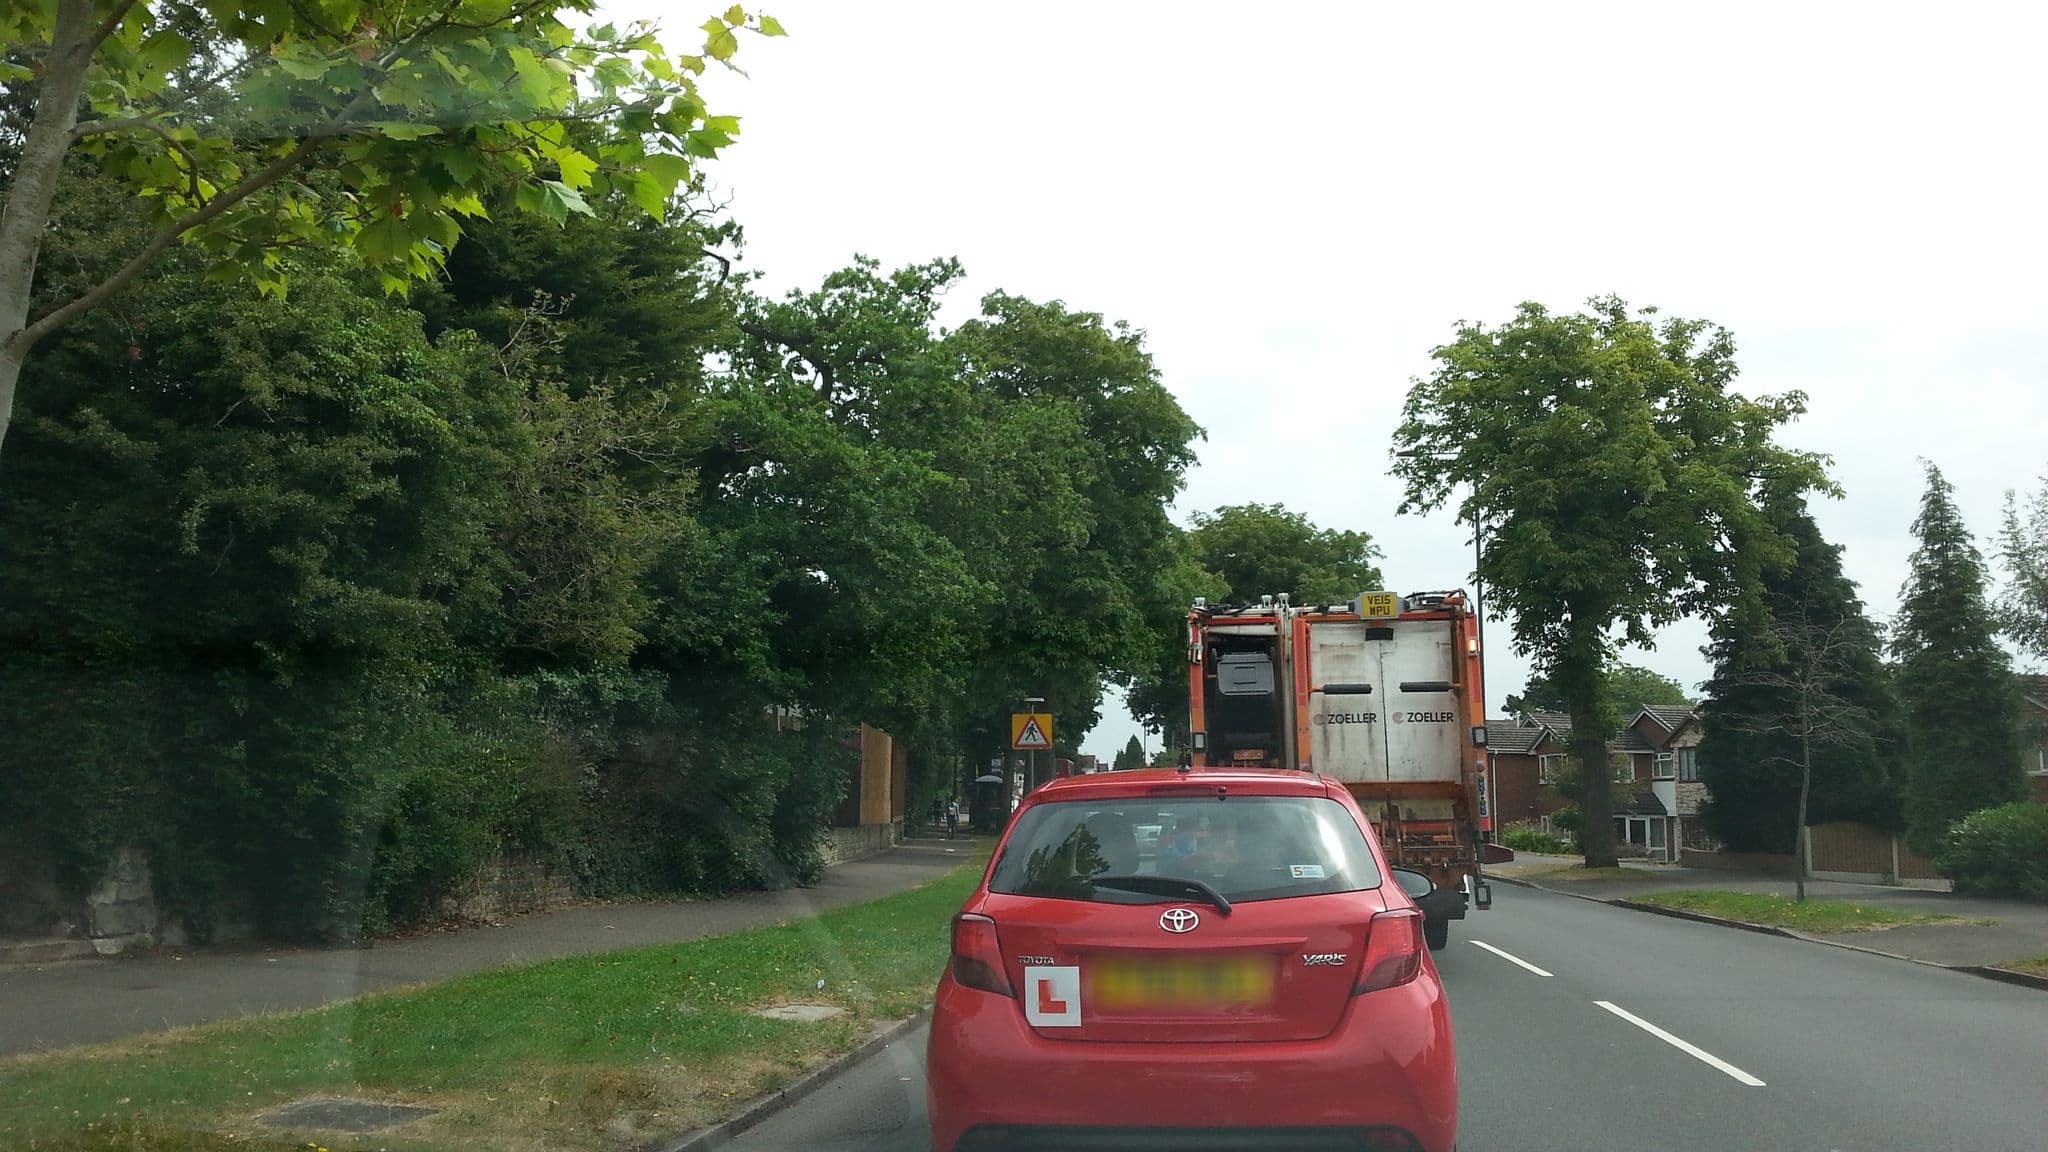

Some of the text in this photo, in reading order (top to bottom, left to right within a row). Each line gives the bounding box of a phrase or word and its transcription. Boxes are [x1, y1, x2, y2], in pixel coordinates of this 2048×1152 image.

[1327, 712, 1377, 725] ZOELLER
[1407, 712, 1454, 723] ZOELLER
[1017, 955, 1055, 965] TOYOTA
[1302, 953, 1347, 966] YARIS
[1037, 979, 1067, 1014] L
